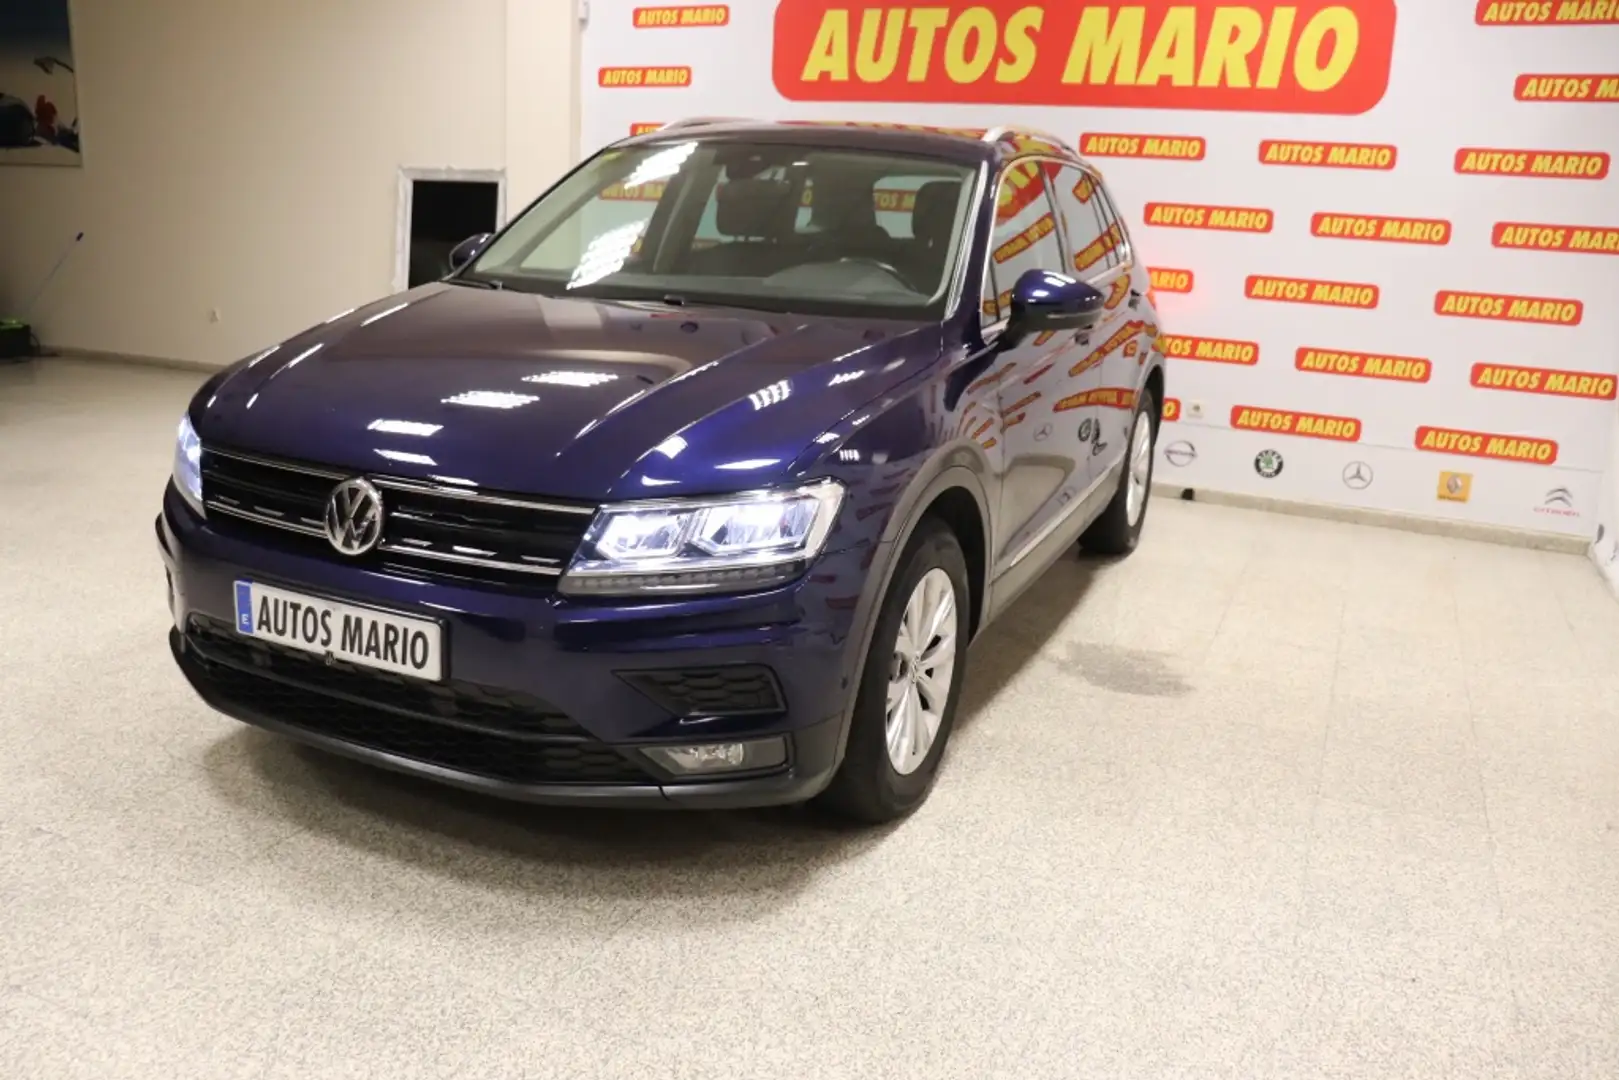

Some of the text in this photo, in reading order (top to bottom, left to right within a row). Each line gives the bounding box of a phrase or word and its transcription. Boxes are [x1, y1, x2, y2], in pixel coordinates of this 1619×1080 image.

[637, 7, 726, 25] AUTOS MARIO
[1484, 0, 1619, 21] AUTOS MARI
[801, 4, 1360, 92] AUTOS MARIO
[602, 69, 688, 85] AUTOS MARIO
[1522, 78, 1592, 98] AUTOS
[1086, 136, 1201, 157] AUTOS MARIO
[1264, 143, 1391, 167] AUTOS MARIO
[1462, 152, 1602, 176] AUTOS MARIO
[1150, 205, 1268, 229] AUTOS MARIO
[1317, 216, 1446, 241] AUTOS MARIO
[1500, 225, 1619, 251] AUTOS MAR
[1151, 271, 1189, 289] ARIO
[1252, 279, 1374, 305] AUTOS MARIO
[1442, 295, 1576, 321] AUTOS MARIO
[1195, 341, 1254, 362] MARIO
[1302, 351, 1427, 379] AUTOS MARIO
[1478, 366, 1614, 396] AUTOS MARIO
[1237, 408, 1357, 437] AUTOS MARIO
[1422, 430, 1553, 461] AUTOS MARIO
[257, 595, 430, 670] AUTOS MARIO
